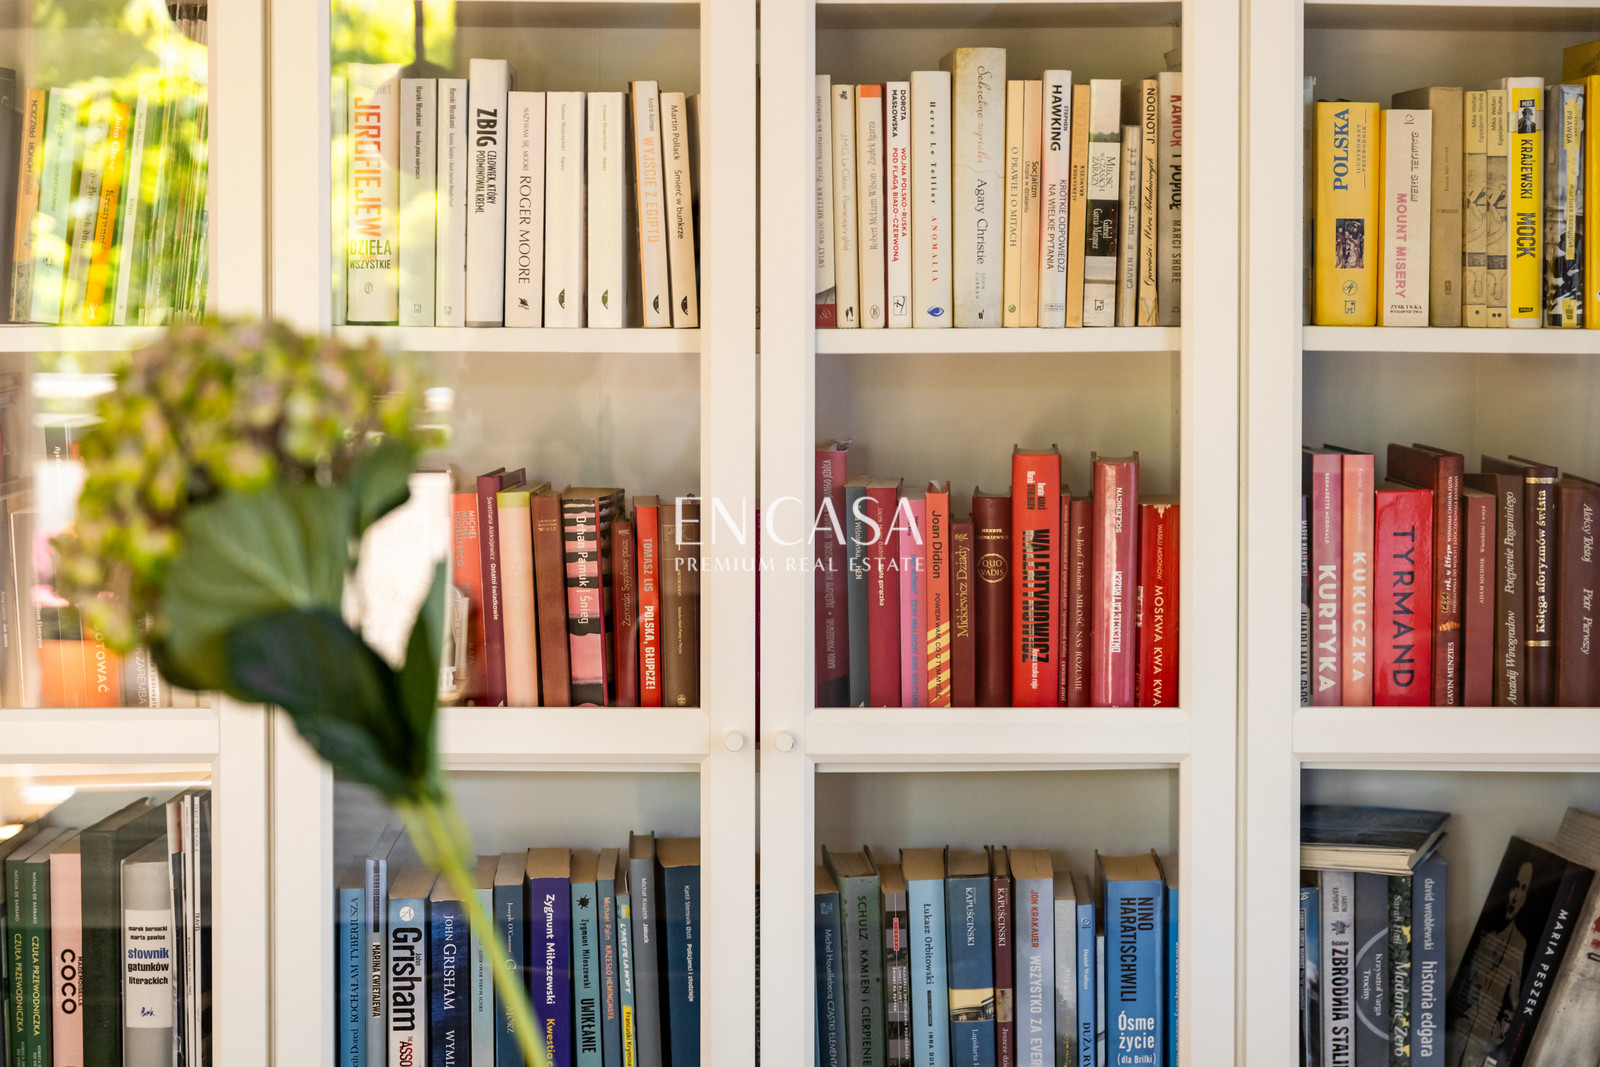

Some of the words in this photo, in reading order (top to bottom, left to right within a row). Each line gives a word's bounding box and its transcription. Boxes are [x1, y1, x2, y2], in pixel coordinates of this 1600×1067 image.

[416, 87, 425, 103] Haruki
[449, 88, 457, 104] Haruki
[416, 105, 425, 128] Murakami
[449, 105, 457, 129] Murakami
[476, 109, 498, 148] ZBIG
[671, 105, 679, 130] Martin
[1049, 85, 1062, 151] HAWKING
[1565, 110, 1573, 144] PRAWDA
[643, 137, 658, 187] WYJŚCIE
[673, 133, 682, 161] Pollack
[1333, 109, 1349, 192] POLSKA
[1411, 131, 1420, 171] SAMUEL
[355, 98, 381, 237] JEROFIEJEW
[475, 151, 486, 192] PODMINOWAŁ
[674, 170, 684, 197] Śmierć
[868, 173, 878, 197] Wilson
[1029, 161, 1040, 198] Socjalizm
[1411, 174, 1419, 201] SHEM
[1520, 139, 1535, 199] KRAJEWSKI
[518, 176, 532, 225] ROGER
[1047, 198, 1056, 231] WIELKIE
[1058, 180, 1068, 213] KRÓTKIE
[647, 202, 660, 243] EGIPTU
[676, 207, 686, 240] bunkrze
[891, 192, 899, 262] BIAŁO-CZERWONĄ
[1009, 210, 1018, 247] MITACH
[1172, 219, 1181, 249] MARCI
[1396, 193, 1408, 242] MOUNT
[1516, 212, 1537, 259] MOCK
[1567, 214, 1576, 248] Szczygieł
[350, 240, 391, 255] DZIEŁA
[518, 230, 532, 284] MOORE
[869, 227, 879, 249] Robert
[976, 219, 988, 264] Christie
[1046, 234, 1056, 270] PYTANIA
[1056, 217, 1066, 273] ODPOWIEDZI
[350, 260, 391, 269] WSZYSTKIE
[1172, 253, 1181, 283] SHORE
[1395, 246, 1407, 298] MISERY
[931, 510, 942, 539] Joan
[1115, 487, 1123, 534] SOŁŻENICYN
[1504, 491, 1517, 547] Paganiniego
[1537, 489, 1548, 527] świata
[1581, 504, 1594, 535] Aleksy
[455, 510, 464, 567] HOUELLEBECQ
[576, 516, 587, 549] Orhan
[577, 552, 591, 588] Pamuk
[643, 538, 654, 575] TOMASZ
[933, 541, 944, 579] Didion
[954, 545, 971, 580] Dziady
[1075, 560, 1084, 591] Tischner
[1504, 548, 1517, 594] Potępienie
[1536, 530, 1548, 592] aforyzmów
[491, 585, 501, 620] świadkowie
[644, 578, 653, 592] LIS
[1022, 528, 1051, 664] WALENTYNOWICZ
[1582, 588, 1594, 611] Piotr
[578, 595, 593, 625] Śnieg
[643, 605, 655, 645] POLSKA,
[956, 582, 969, 638] Mickiewicz
[1076, 594, 1085, 626] MIŁOŚĆ
[1155, 585, 1165, 643] MOSKWA
[1352, 552, 1367, 683] KUKUCZKA
[1392, 525, 1416, 689] TYRMAND
[1536, 594, 1548, 634] Księga
[1318, 564, 1336, 693] KURTYKA
[1505, 610, 1518, 667] Winogradow
[1580, 616, 1594, 656] Pierwszy
[645, 647, 656, 690] GŁUPCZE!
[1075, 650, 1083, 692] ROZUMIE
[1154, 646, 1163, 675] KWA
[1447, 642, 1455, 680] MENZIES
[1447, 681, 1455, 705] GAVIN
[1030, 890, 1039, 905] JON
[1423, 877, 1435, 900] david
[350, 897, 359, 962] TYBERIUSZA
[444, 914, 455, 941] JOHN
[544, 894, 556, 940] Zygmunt
[641, 898, 650, 921] Książek
[857, 896, 868, 941] SCHULZ
[923, 903, 933, 934] Łukasz
[965, 887, 978, 947] KAPUŚCIŃSKI
[996, 887, 1010, 947] KAPUŚCIŃSKI
[1030, 906, 1040, 948] KRAKAUER
[1137, 897, 1155, 932] NINO
[1423, 902, 1434, 951] wroblewski
[14, 932, 24, 961] CZUŁA
[32, 935, 41, 963] CZUŁA
[580, 918, 590, 947] Zygmunt
[1120, 897, 1138, 1003] HARATISCHWILI
[1545, 908, 1569, 956] MARIA
[128, 947, 169, 959] słownik
[128, 963, 169, 972] gatunków
[372, 945, 380, 973] MARINA
[581, 949, 591, 989] Miłoszewski
[925, 936, 935, 985] Orbitowski
[61, 948, 78, 1014] COCO
[128, 976, 169, 984] literackich
[392, 927, 423, 1032] Grisham
[443, 944, 457, 1011] GRISHAM
[546, 942, 556, 1005] Miłoszewski
[1029, 955, 1043, 1014] WSZYSTKO
[1360, 970, 1372, 1001] Trociny
[1420, 961, 1438, 1010] historia
[1522, 963, 1551, 1017] PESZEK
[14, 962, 24, 1033] PRZEWODNICZKA
[32, 964, 41, 1036] PRZEWODNICZKA
[350, 965, 359, 1024] KOCHAŁAM
[372, 974, 381, 1018] CWIETAJEWA
[580, 998, 597, 1054] UWIKŁANIE
[861, 1006, 873, 1066] CIERPIENIE
[1082, 1021, 1093, 1052] DUŻA
[1118, 1010, 1155, 1031] Ósme
[1416, 1012, 1437, 1058] edgara
[1118, 1033, 1155, 1052] życie
